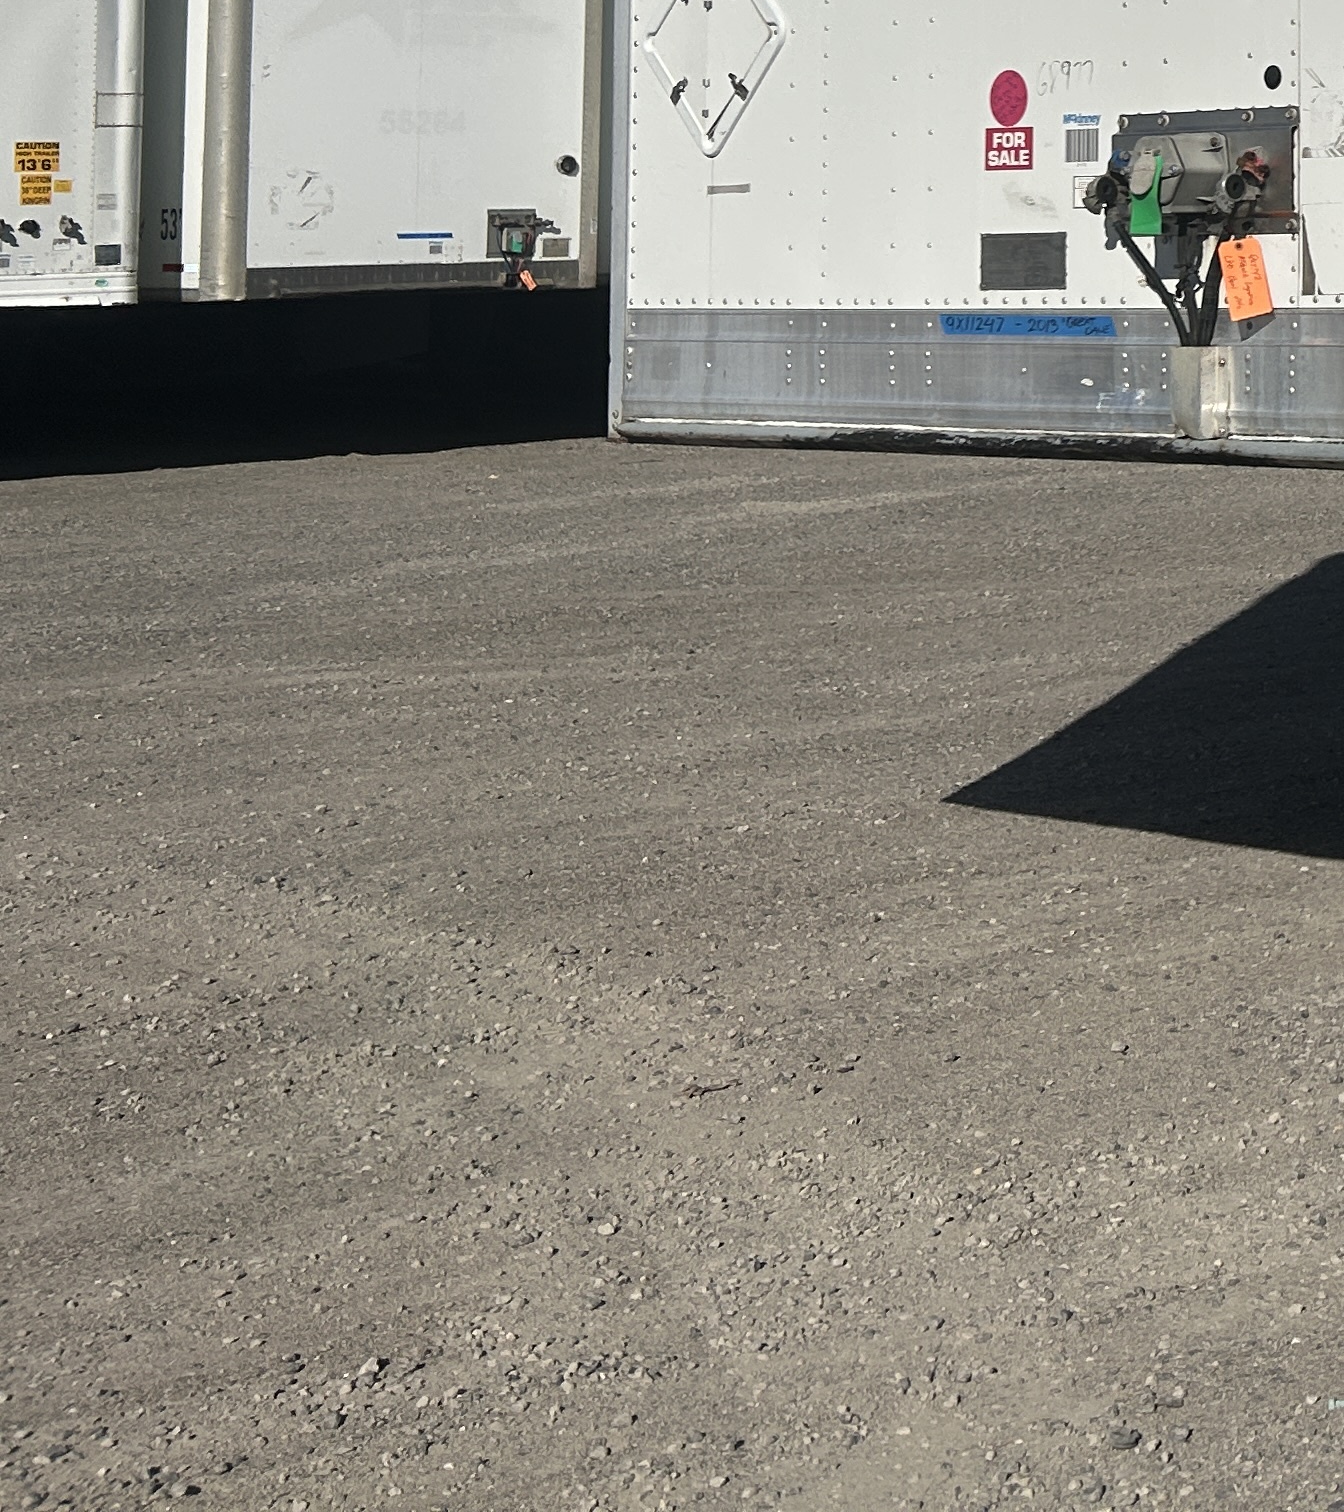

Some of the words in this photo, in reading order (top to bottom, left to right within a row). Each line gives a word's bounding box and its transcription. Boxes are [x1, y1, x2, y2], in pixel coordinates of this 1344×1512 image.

[16, 141, 60, 150] CAUTION
[992, 131, 1026, 149] FOR
[987, 149, 1030, 167] SALE
[21, 175, 52, 184] CAUTION
[1027, 318, 1060, 334] 2013
